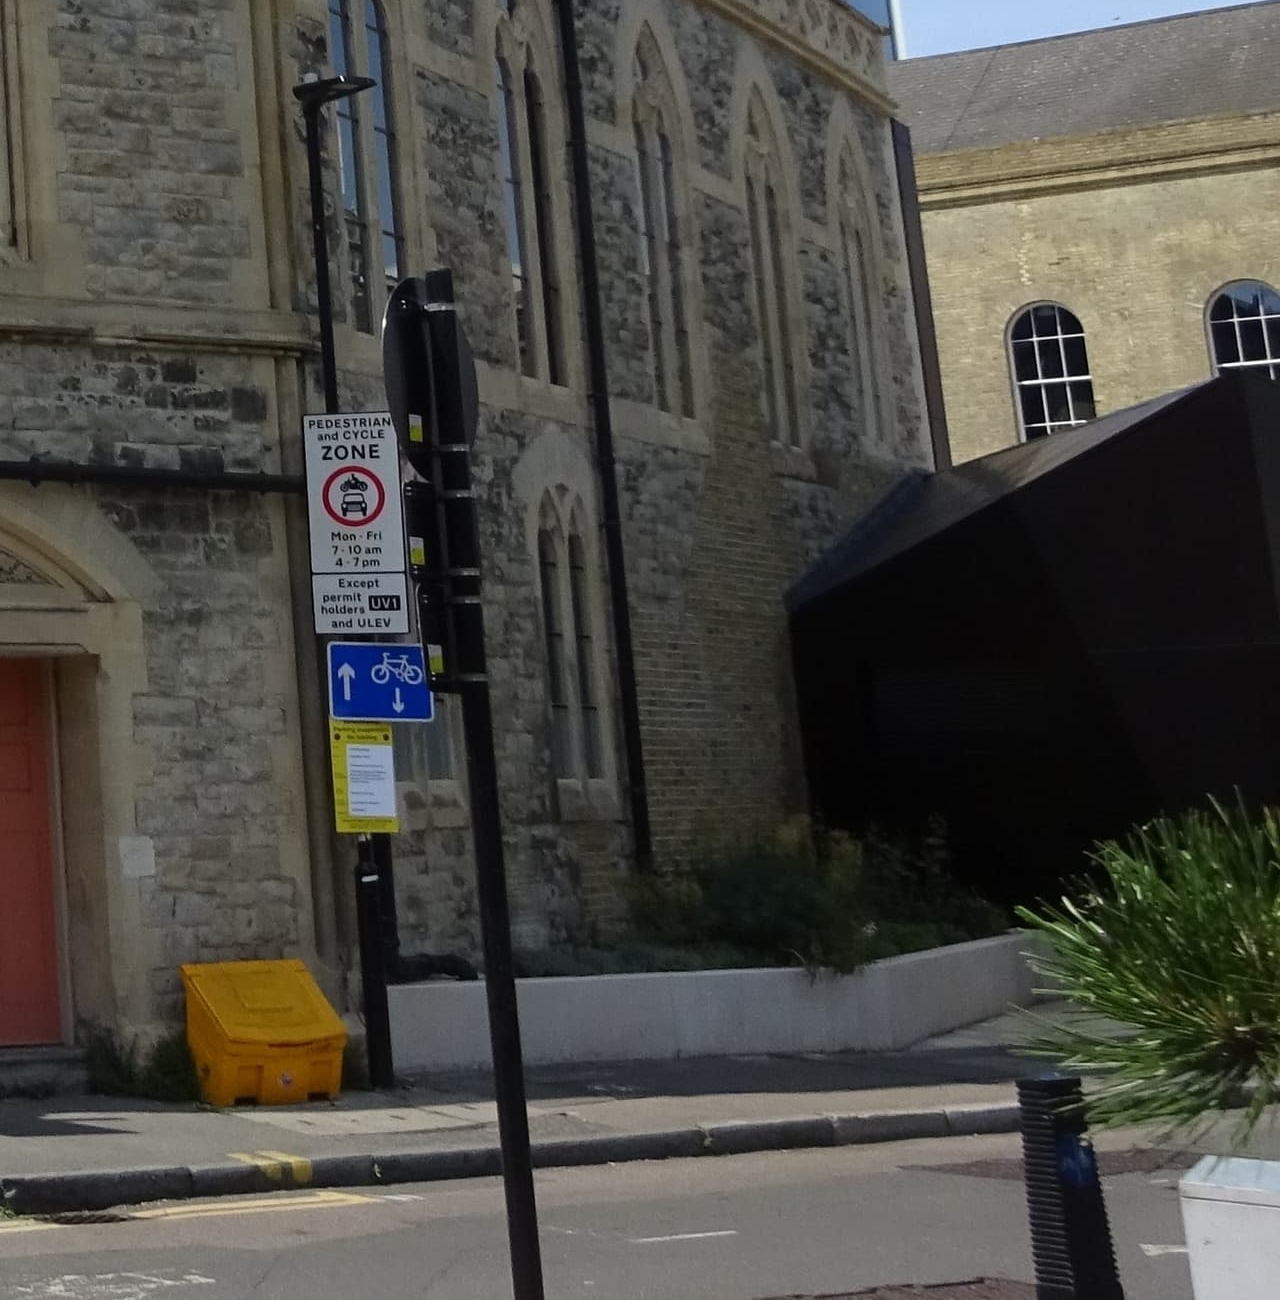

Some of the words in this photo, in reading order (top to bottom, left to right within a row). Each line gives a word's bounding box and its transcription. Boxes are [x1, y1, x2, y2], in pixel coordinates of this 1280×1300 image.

[309, 417, 391, 428] PEDESTRIAN
[317, 431, 338, 441] and
[343, 429, 385, 440] CYCLE
[321, 444, 380, 460] ZONE
[331, 532, 357, 541] Mon
[366, 531, 382, 540] Fri
[331, 545, 338, 555] 7
[348, 544, 362, 555] 10
[335, 557, 343, 567] 4
[352, 557, 359, 567] 7
[362, 559, 380, 568] pm
[338, 579, 380, 589] Except
[323, 593, 362, 603] permit
[371, 597, 397, 609] UV1
[321, 605, 365, 614] holders
[331, 618, 353, 628] and
[357, 617, 391, 628] ULEV
